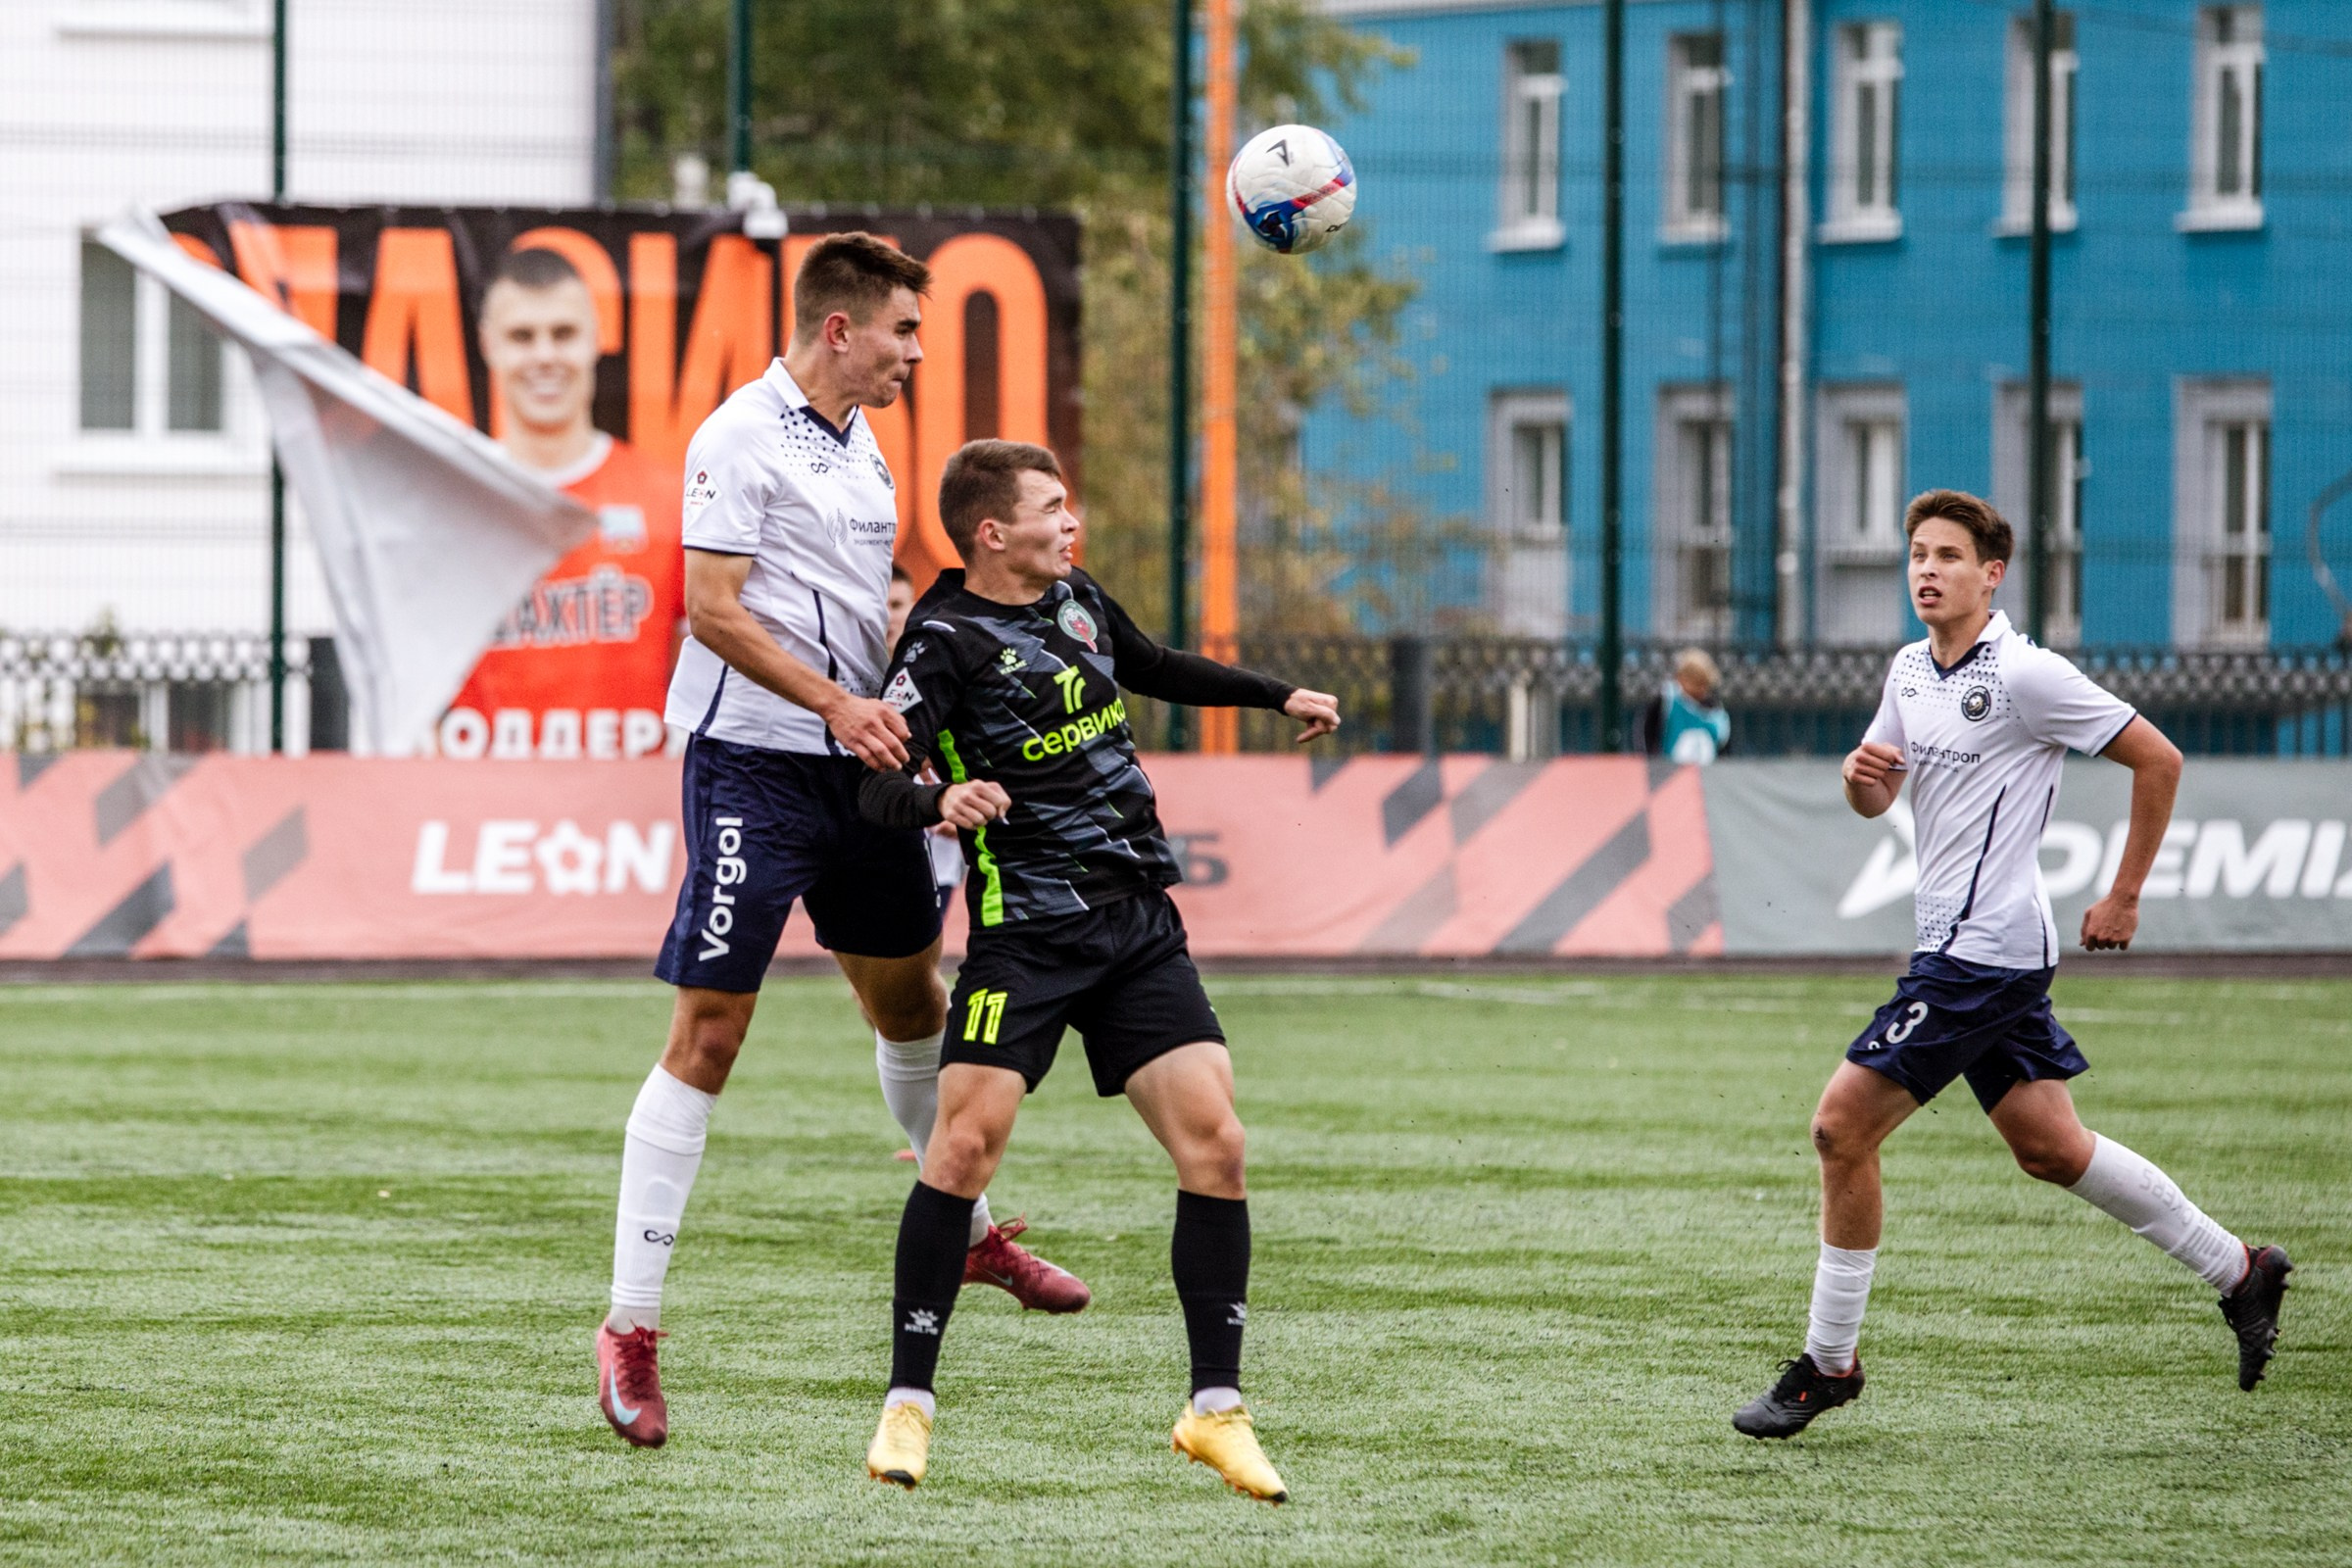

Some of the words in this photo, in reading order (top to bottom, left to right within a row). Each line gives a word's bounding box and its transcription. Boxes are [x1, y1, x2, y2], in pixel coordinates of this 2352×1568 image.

[494, 566, 651, 647] АХТЁР
[1000, 659, 1028, 675] KELME
[437, 706, 688, 760] ОДДЕР
[2037, 820, 2352, 899] DEMI
[698, 816, 748, 961] Vorgol
[963, 988, 1007, 1045] 11
[1886, 1002, 1929, 1045] 3
